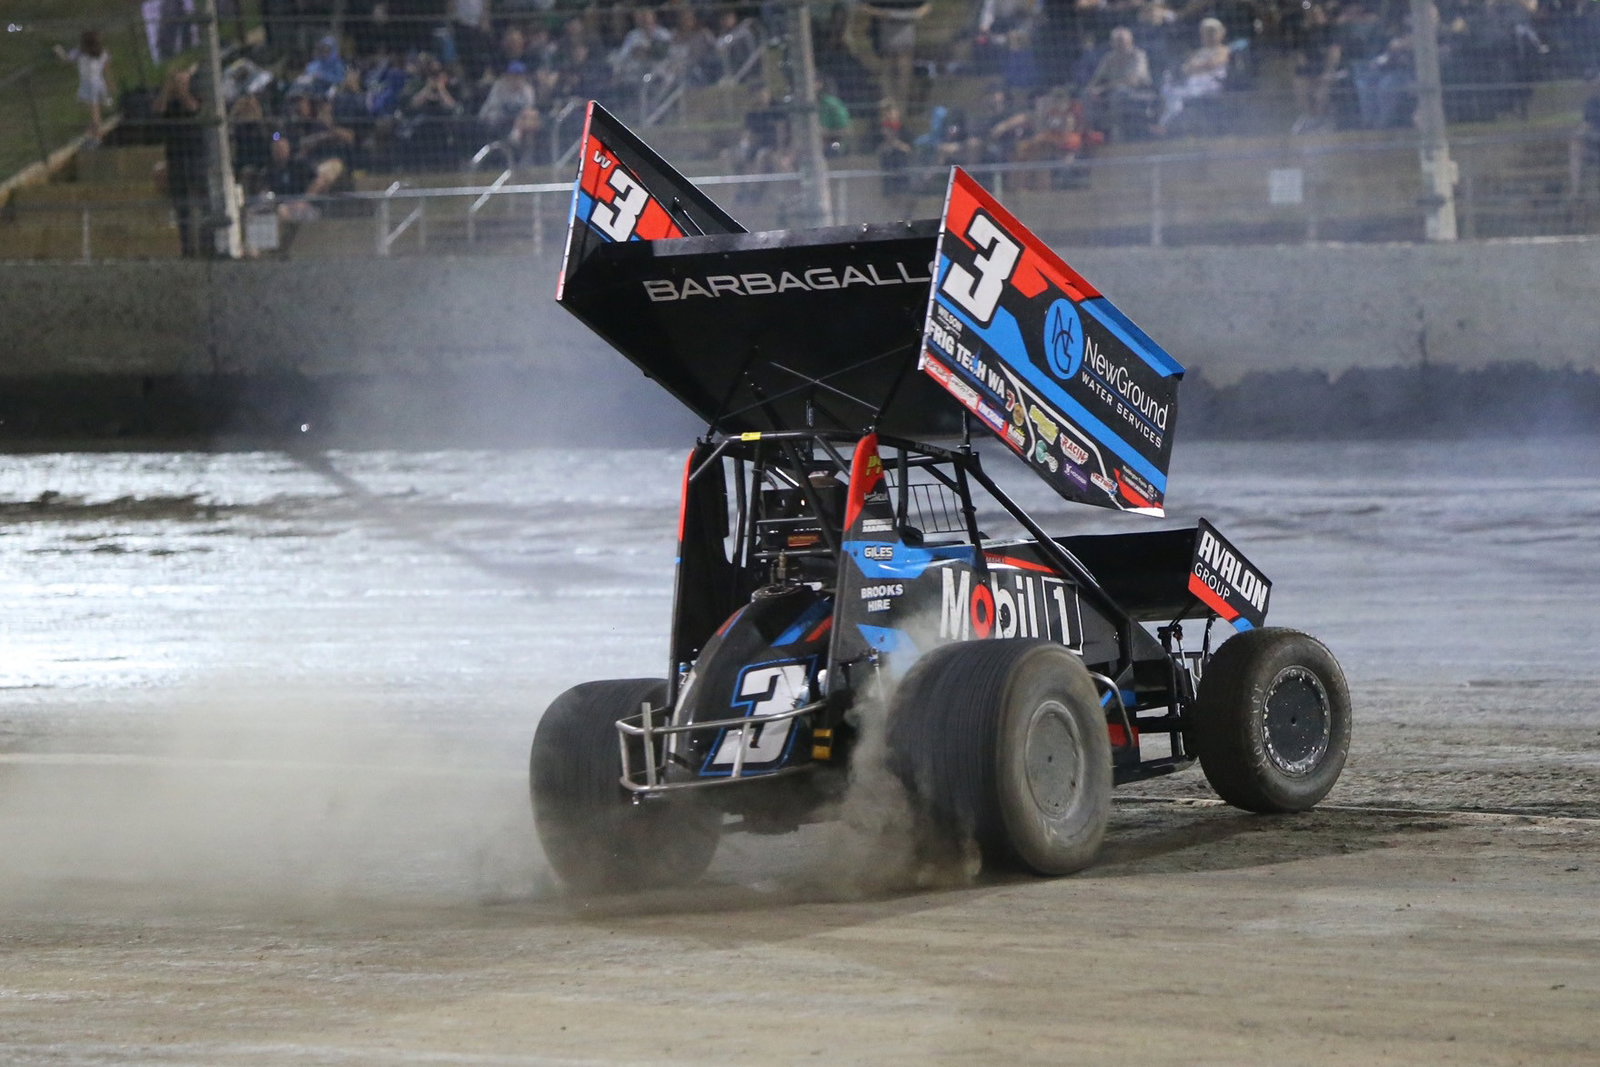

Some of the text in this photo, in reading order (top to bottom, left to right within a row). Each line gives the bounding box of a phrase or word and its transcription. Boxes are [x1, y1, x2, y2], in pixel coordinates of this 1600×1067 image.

[591, 169, 649, 242] 3
[642, 261, 933, 302] BARBAGALL
[942, 214, 1020, 322] 3
[928, 319, 955, 356] FRIG
[988, 368, 1005, 399] WA
[1084, 336, 1169, 431] NewGround
[1082, 371, 1162, 448] WATER SERVICES
[864, 546, 893, 558] GILES
[1194, 562, 1231, 600] GROUP
[1198, 530, 1268, 613] AVALON
[860, 584, 904, 599] BROOKS
[867, 598, 891, 612] HIRE
[940, 567, 1071, 646] Mobil 1
[712, 664, 807, 765] 3
